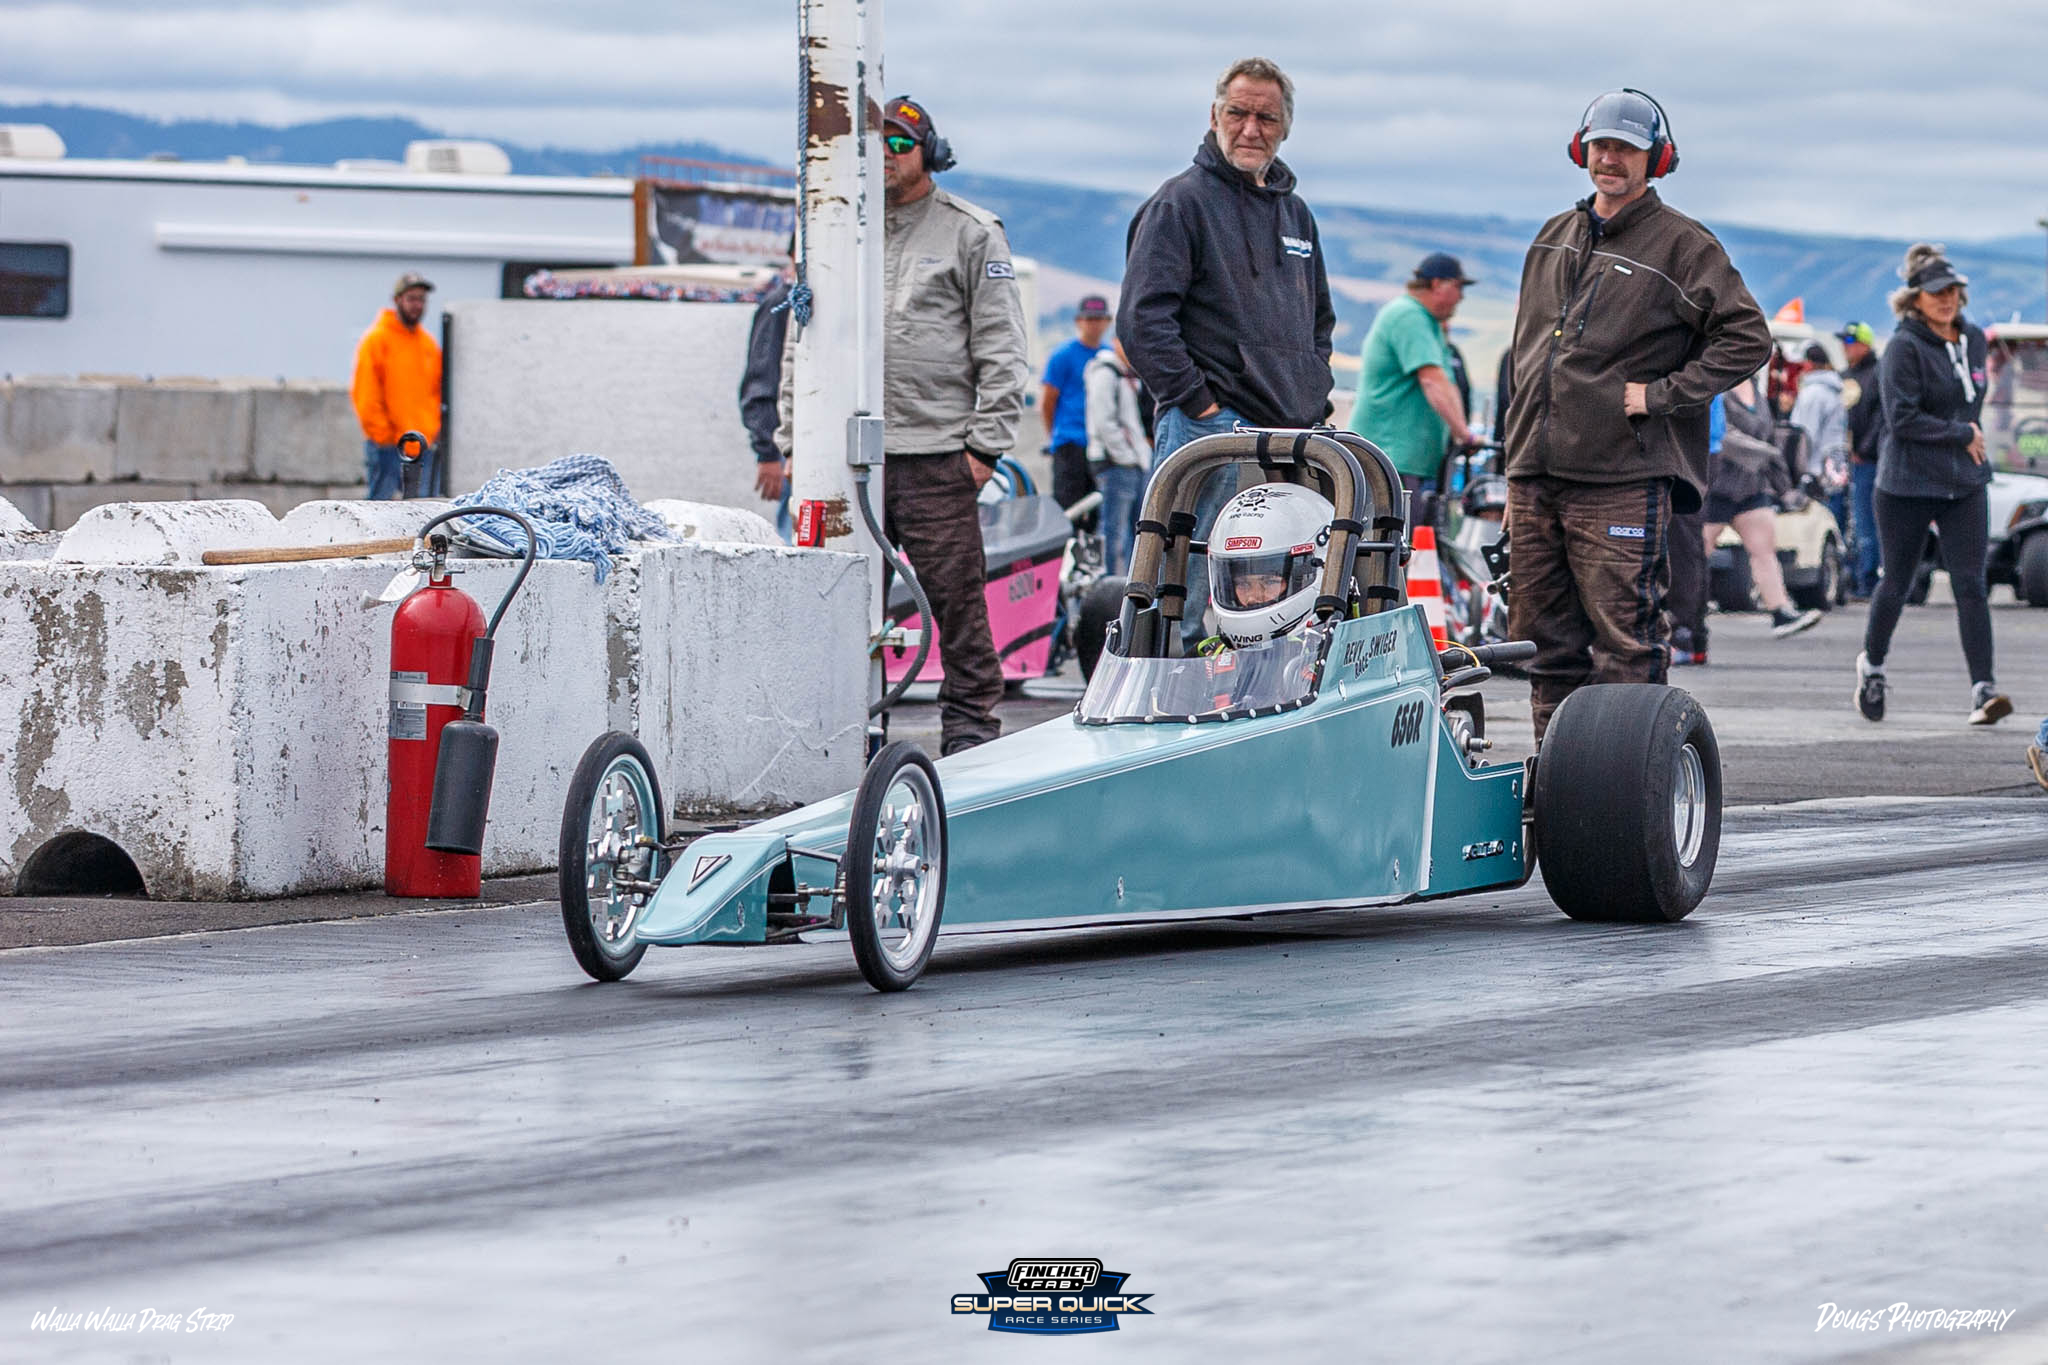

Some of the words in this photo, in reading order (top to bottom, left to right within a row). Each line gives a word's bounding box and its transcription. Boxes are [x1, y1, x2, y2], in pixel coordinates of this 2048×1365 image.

[1227, 539, 1258, 548] SIMPSON
[1293, 544, 1313, 553] SIMPSON
[1230, 634, 1263, 643] WING
[1369, 629, 1398, 658] SWIGER
[1355, 652, 1369, 679] RACE
[1391, 700, 1424, 749] 656R
